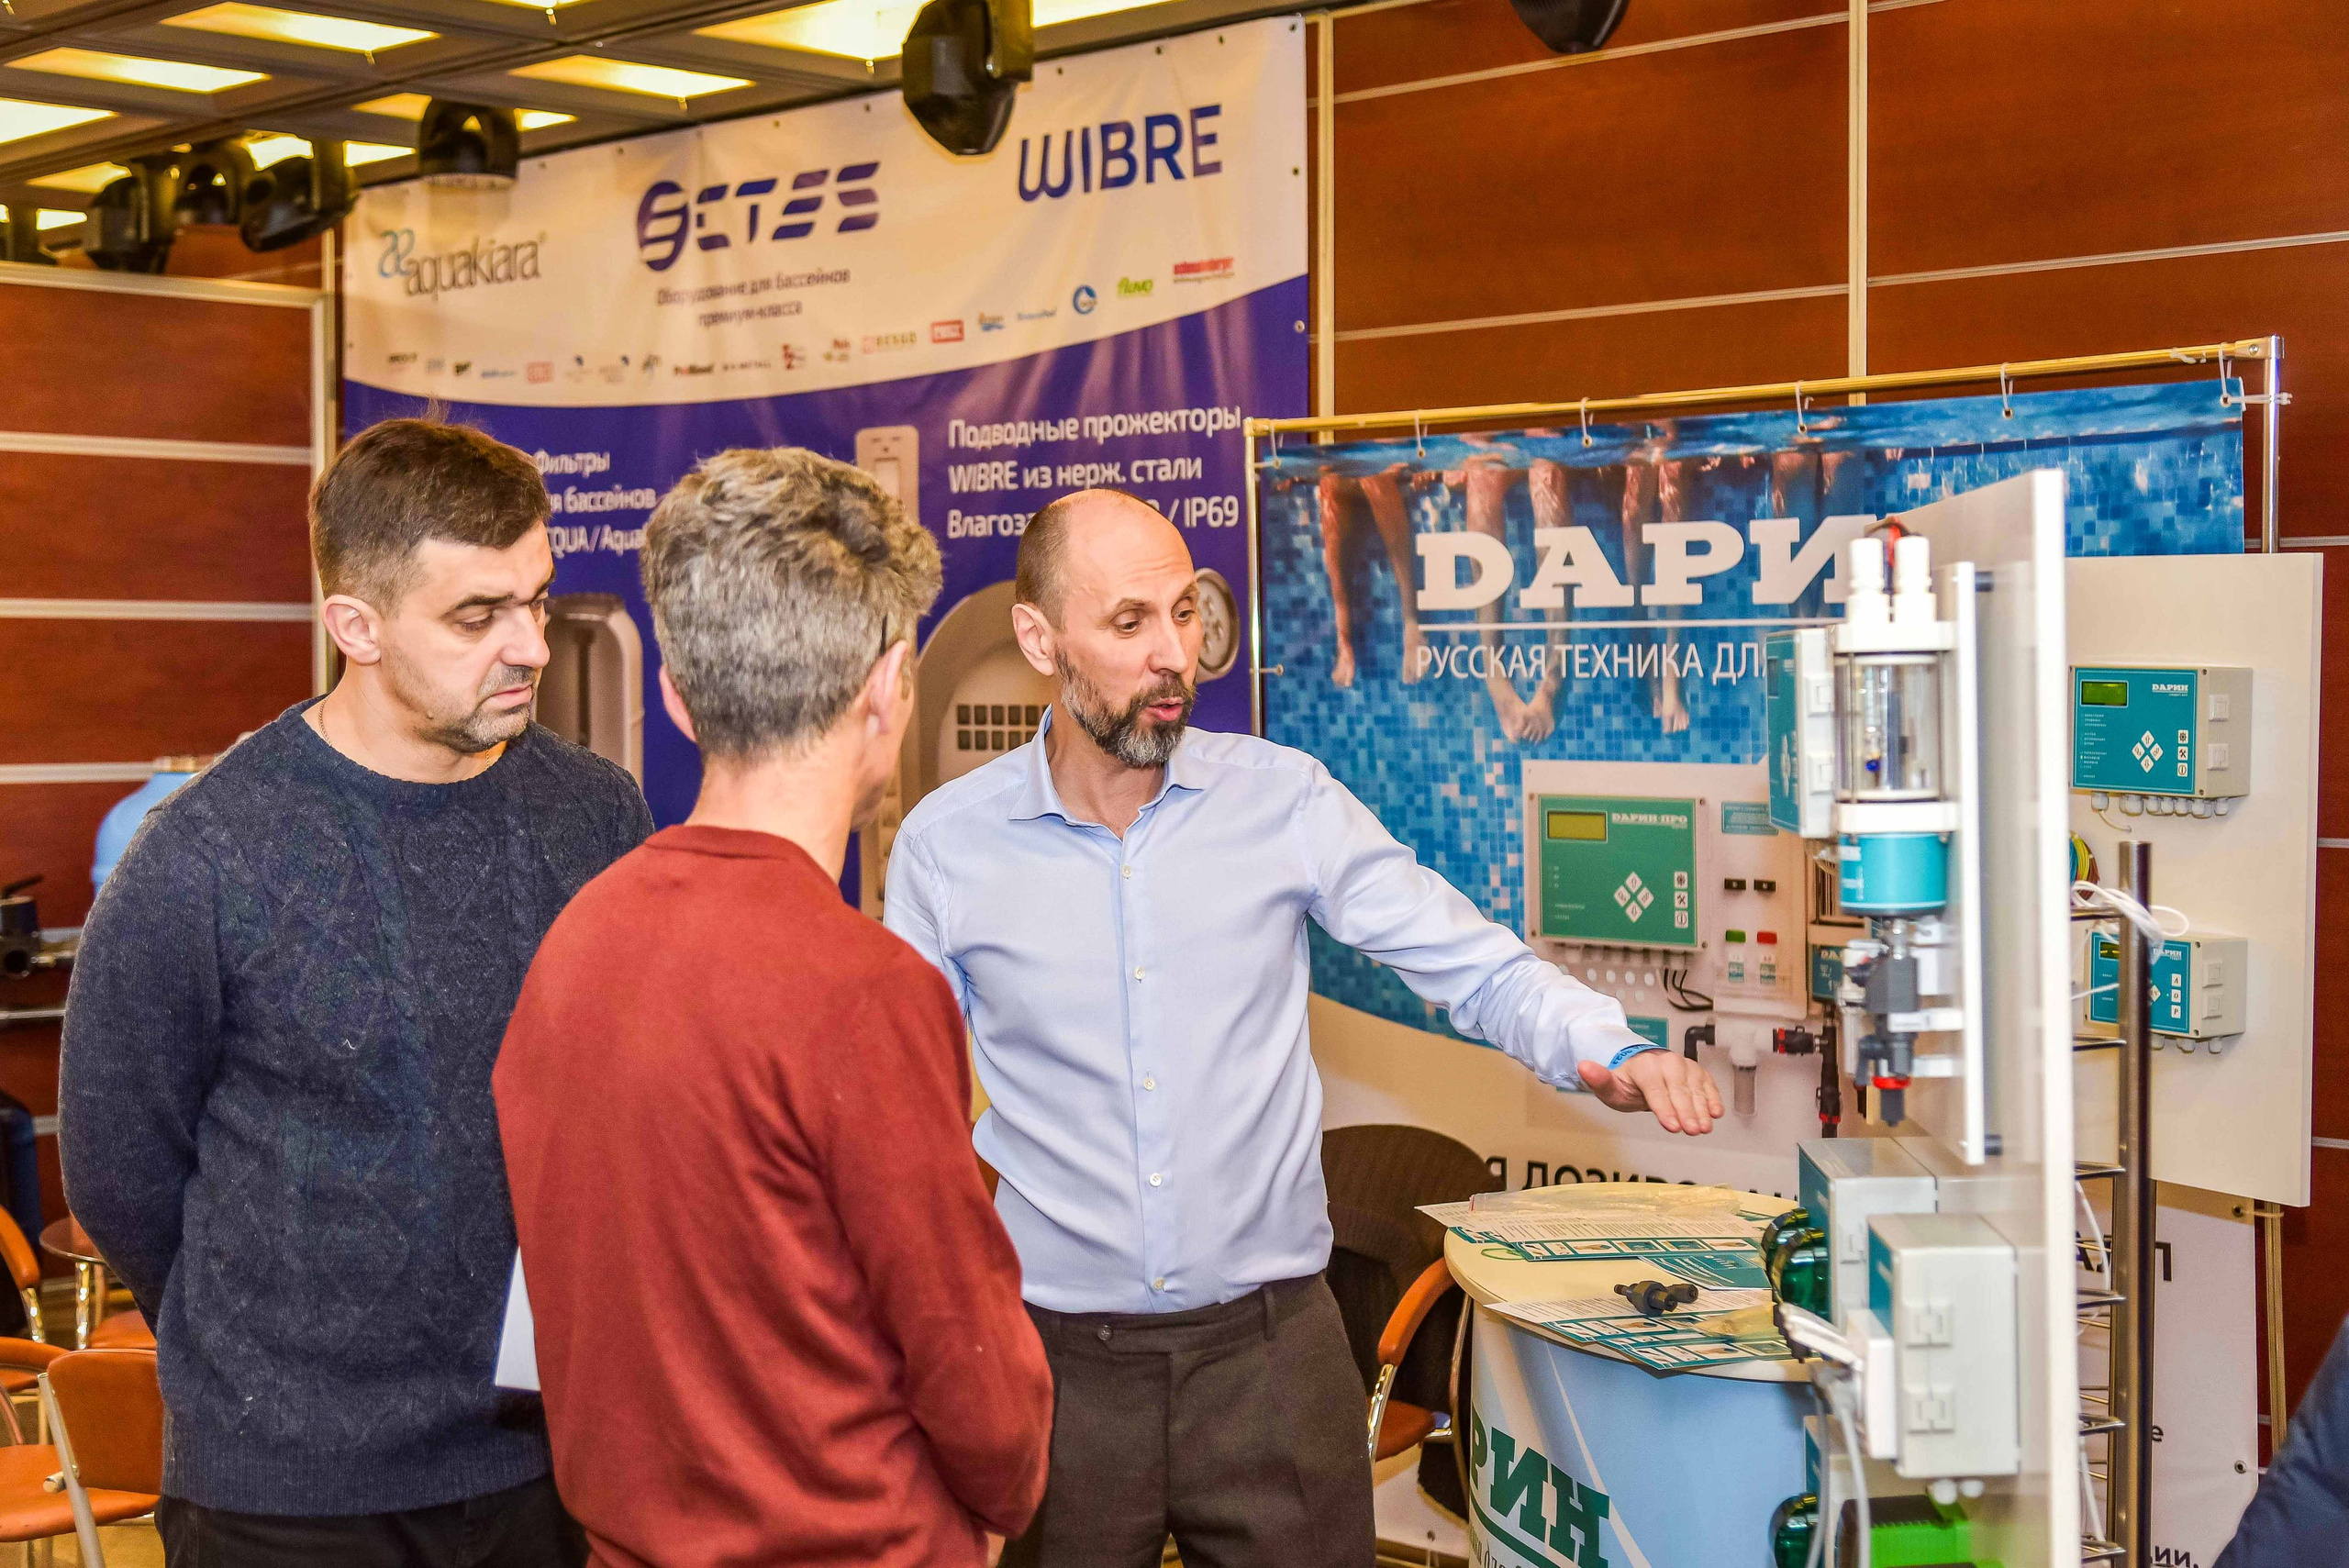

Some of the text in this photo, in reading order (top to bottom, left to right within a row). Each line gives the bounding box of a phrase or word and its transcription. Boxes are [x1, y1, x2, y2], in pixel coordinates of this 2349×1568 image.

[1018, 102, 1224, 204] WIBRE
[405, 235, 541, 301] aquakiara
[750, 278, 773, 295] для
[948, 406, 1241, 450] Подводные прожекторы
[947, 456, 1203, 494] WIBRE из нерж. стали
[563, 484, 657, 515] бассейнов
[947, 508, 1036, 539] Влагоз
[1184, 495, 1240, 528] IP69
[548, 525, 588, 560] QUA
[599, 524, 646, 558] Aqua
[1416, 514, 1878, 612] DАРИ
[1416, 641, 1768, 686] РУССКАЯ ТЕХНИКА ДЛ
